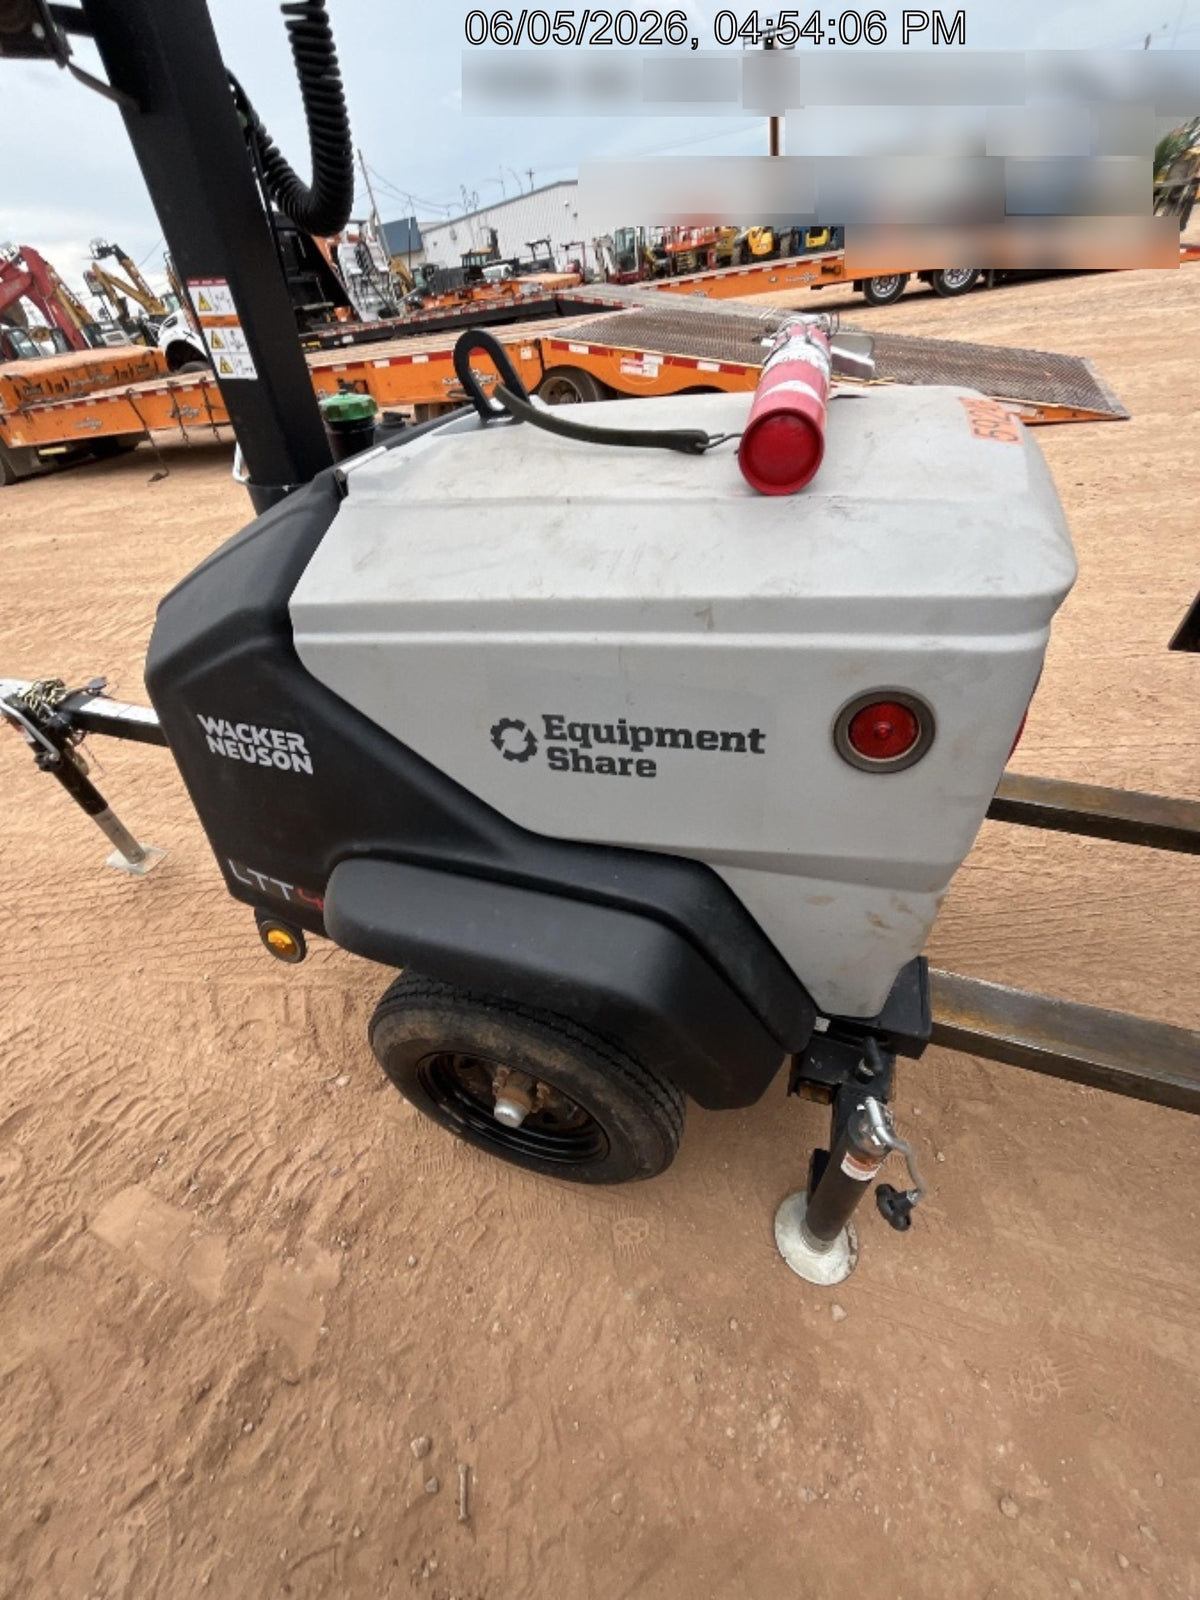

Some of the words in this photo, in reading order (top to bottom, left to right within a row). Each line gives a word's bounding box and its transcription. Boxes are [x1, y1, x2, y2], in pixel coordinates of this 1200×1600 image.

[196, 713, 311, 755] WACKER
[205, 733, 314, 775] NEUSON
[541, 714, 766, 754] Equipment
[547, 746, 657, 778] Share
